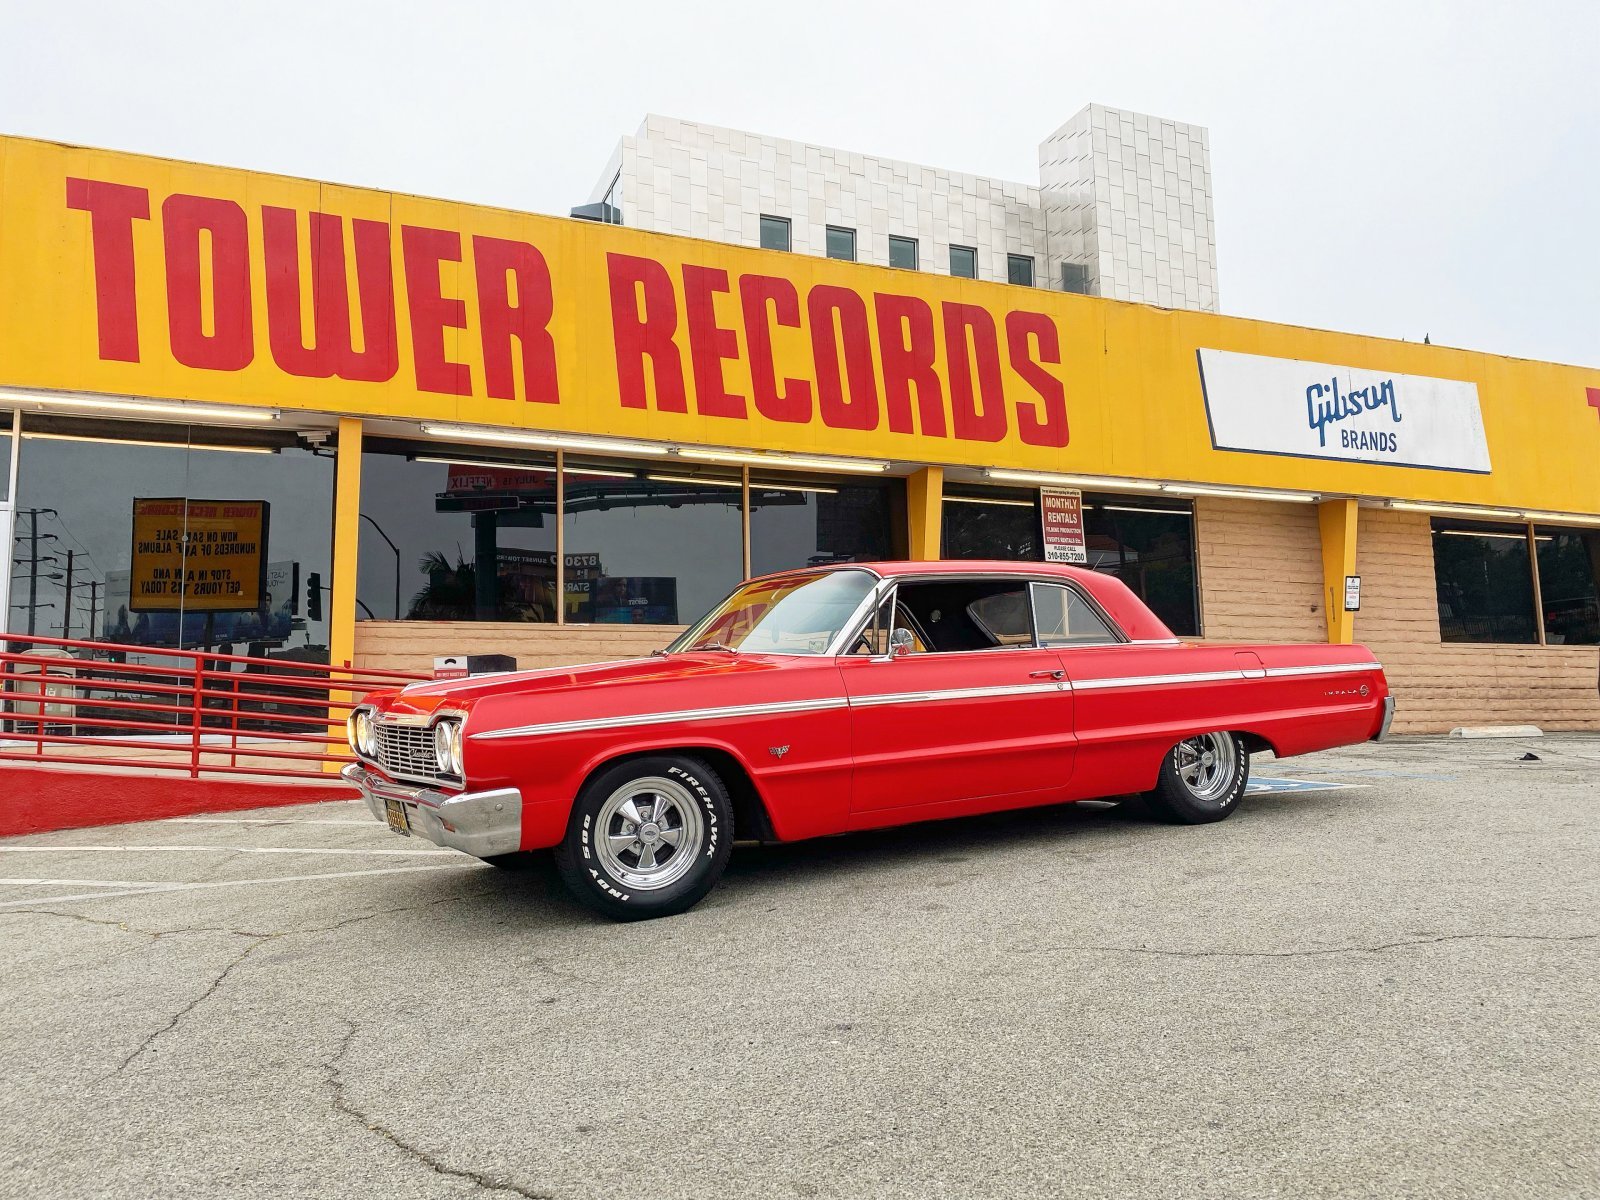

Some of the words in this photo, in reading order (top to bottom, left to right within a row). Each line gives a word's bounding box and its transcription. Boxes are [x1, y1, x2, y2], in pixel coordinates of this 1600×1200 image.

[66, 176, 560, 405] TOWER
[606, 251, 1070, 448] RECORDS
[1306, 376, 1402, 447] Gibson
[1341, 429, 1397, 453] BRANDS
[1045, 497, 1077, 510] MONTHLY
[1047, 512, 1078, 524] RENTALS
[1047, 551, 1085, 561] 310-855-7200
[667, 766, 718, 859] FIREHAWK
[581, 813, 591, 860] 500
[588, 867, 631, 901] INDY
